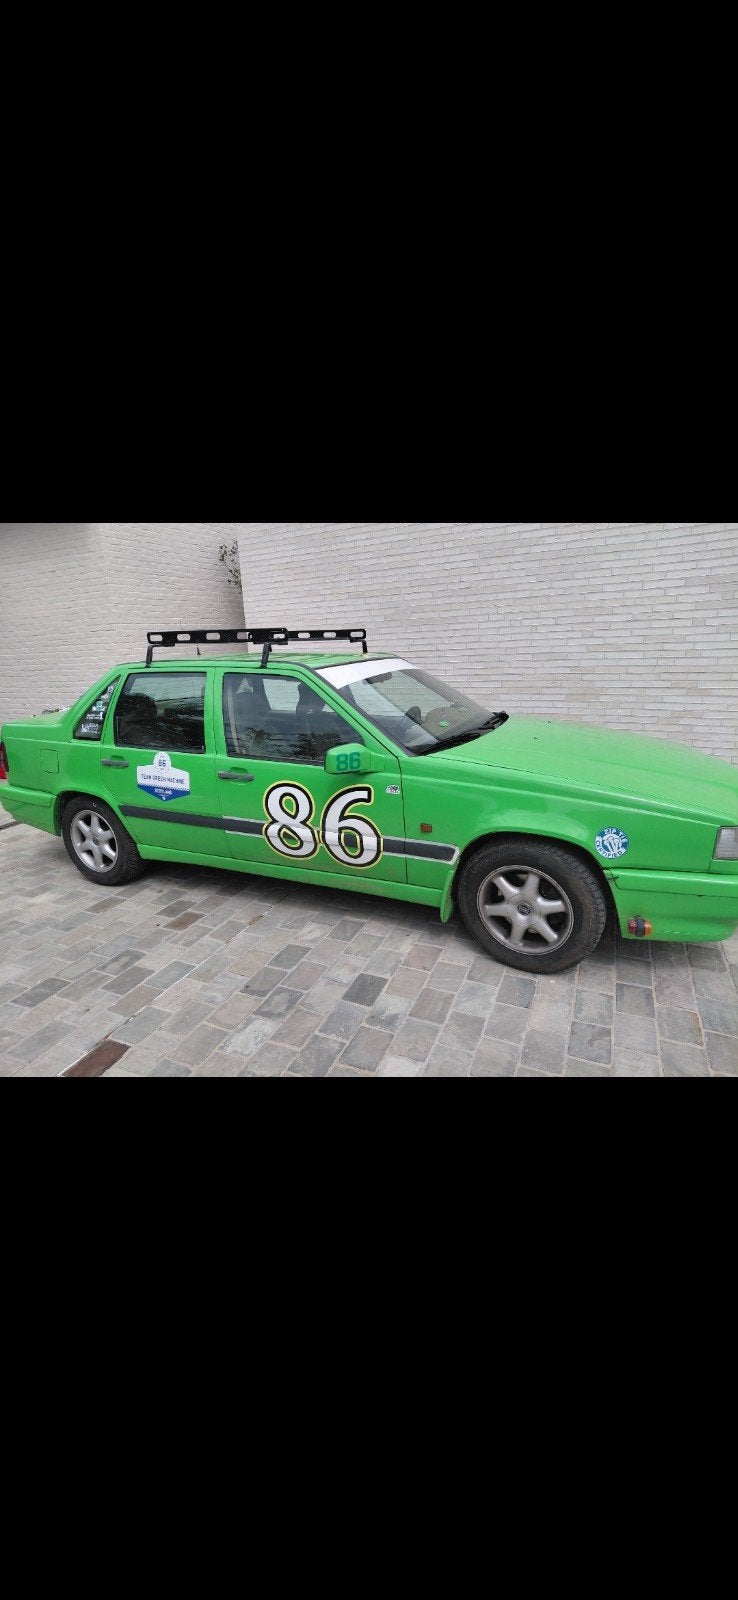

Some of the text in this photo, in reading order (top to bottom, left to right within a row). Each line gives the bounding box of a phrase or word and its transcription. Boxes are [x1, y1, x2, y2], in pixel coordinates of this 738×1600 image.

[158, 759, 167, 767] 86
[336, 751, 361, 771] 86
[167, 777, 185, 785] MACHINE
[262, 780, 384, 869] 86
[619, 831, 628, 843] TIE
[595, 839, 624, 858] CERTIFIED
